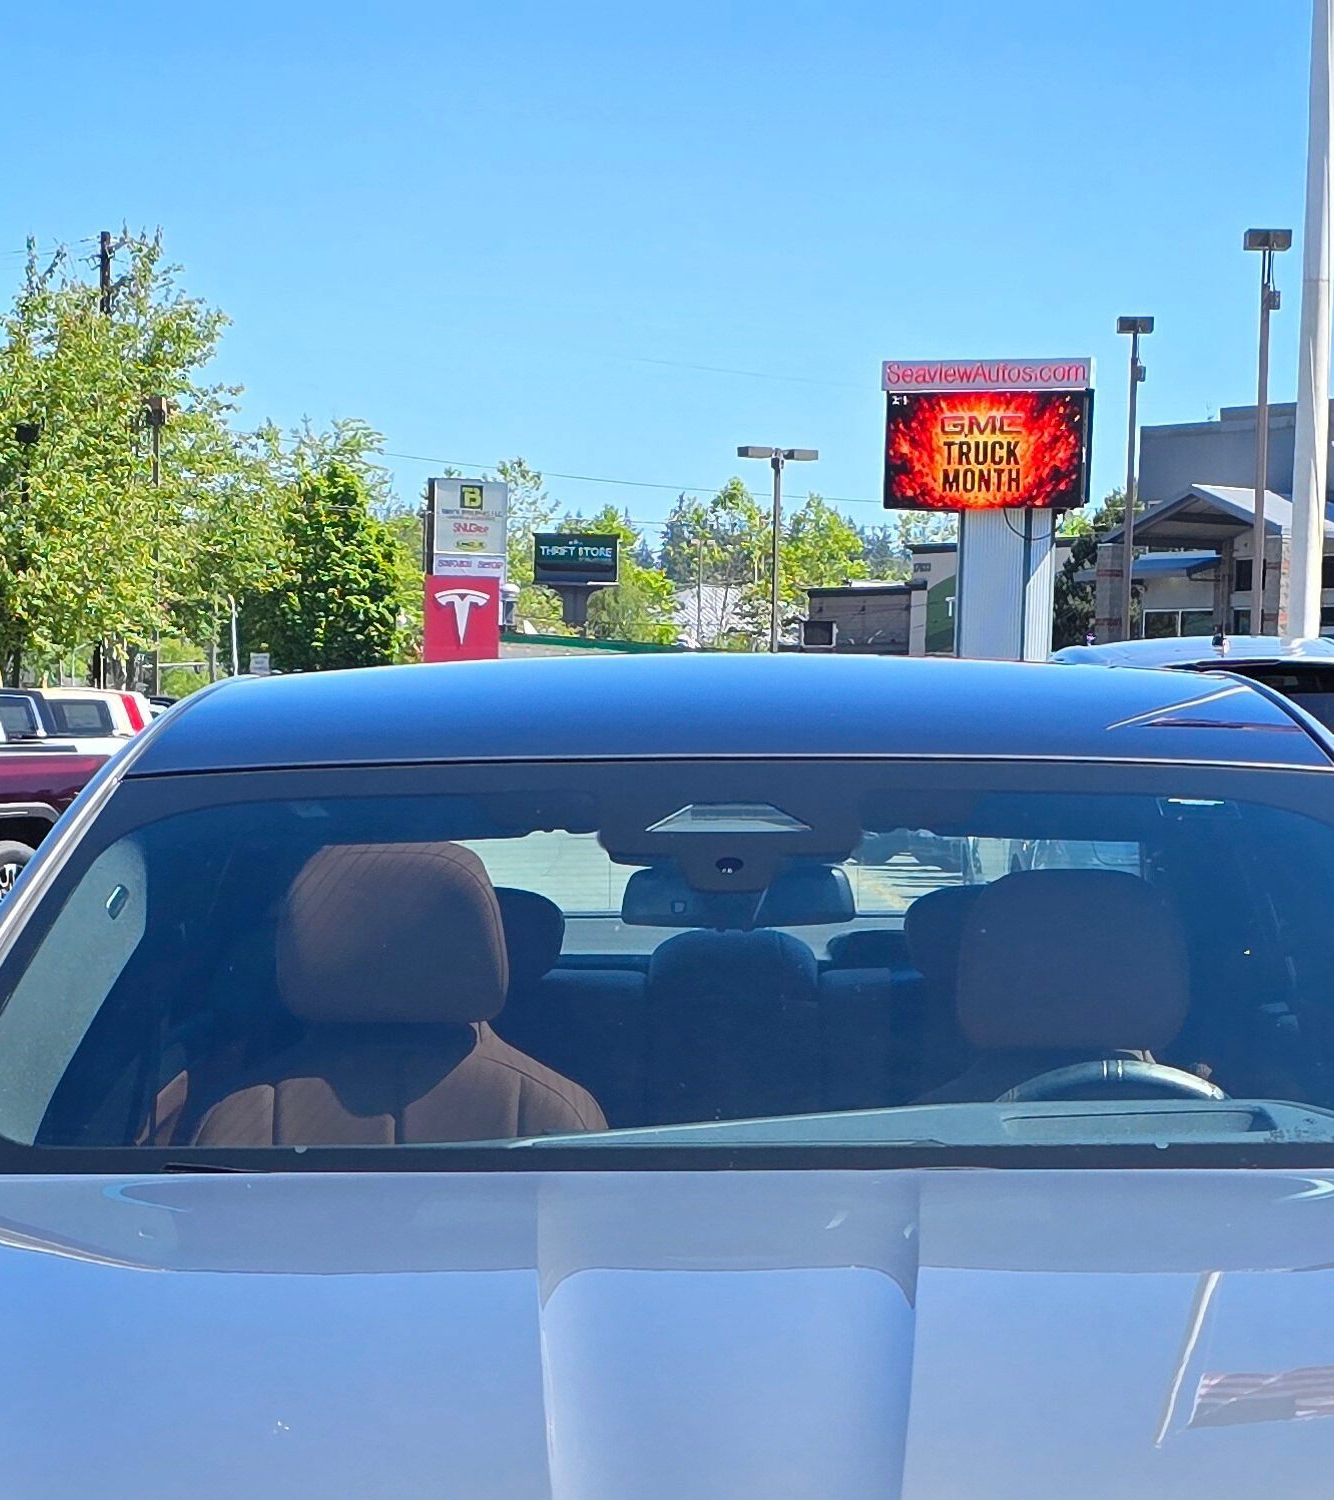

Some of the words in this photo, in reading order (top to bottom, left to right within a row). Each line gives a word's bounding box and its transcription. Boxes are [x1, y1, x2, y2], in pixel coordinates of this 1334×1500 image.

[886, 362, 1086, 384] SeaviewAutos.com
[940, 415, 1023, 435] GMC
[943, 440, 1021, 466] TRUCK
[942, 469, 1021, 492] MONTH
[540, 546, 575, 556] THRIFT
